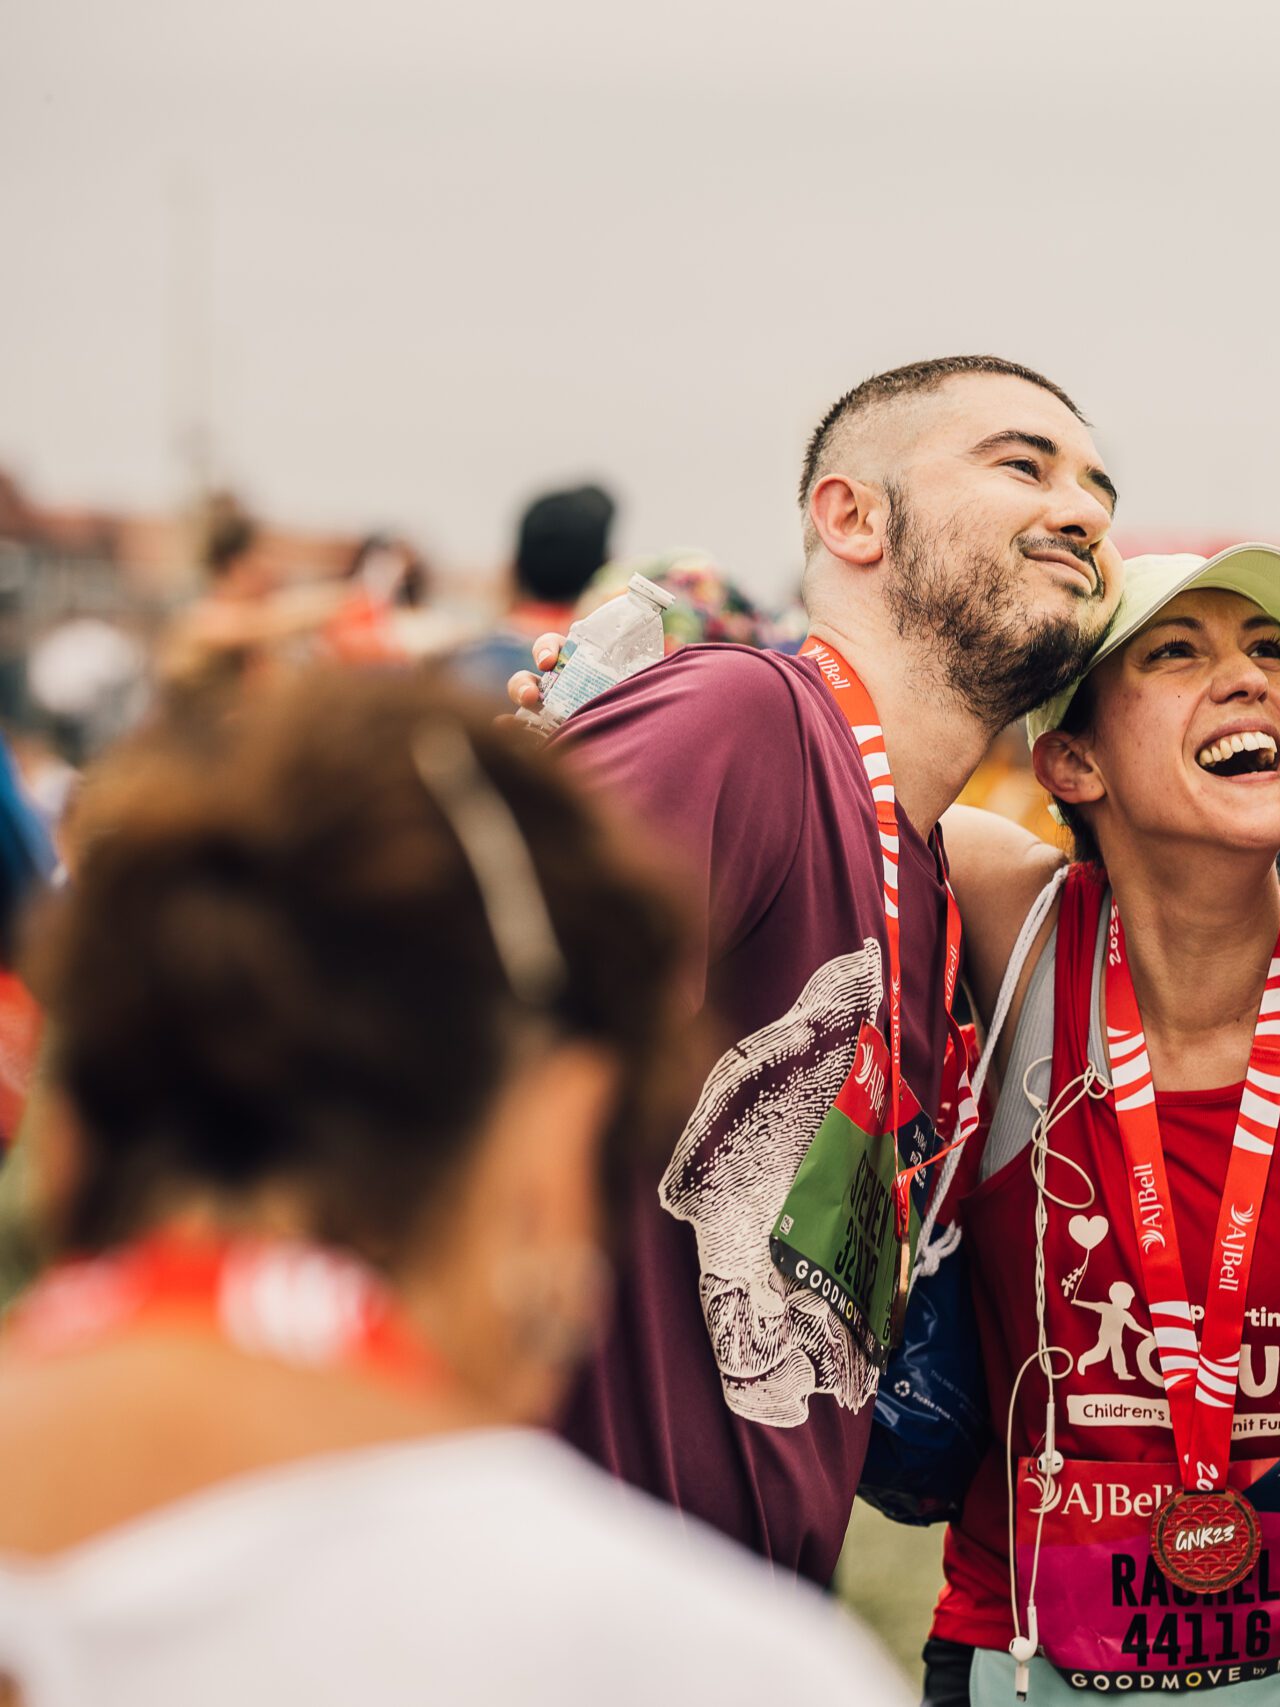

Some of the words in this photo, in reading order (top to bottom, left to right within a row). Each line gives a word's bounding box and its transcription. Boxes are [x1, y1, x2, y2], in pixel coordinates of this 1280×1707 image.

[1132, 1162, 1165, 1229] AJBell
[1218, 1222, 1247, 1292] AJBell
[1083, 1403, 1165, 1422] Children's
[1175, 1525, 1236, 1551] GNR23
[1121, 1609, 1272, 1667] 44116
[1071, 1666, 1242, 1692] GOODMOVE
[1253, 1666, 1267, 1676] by
